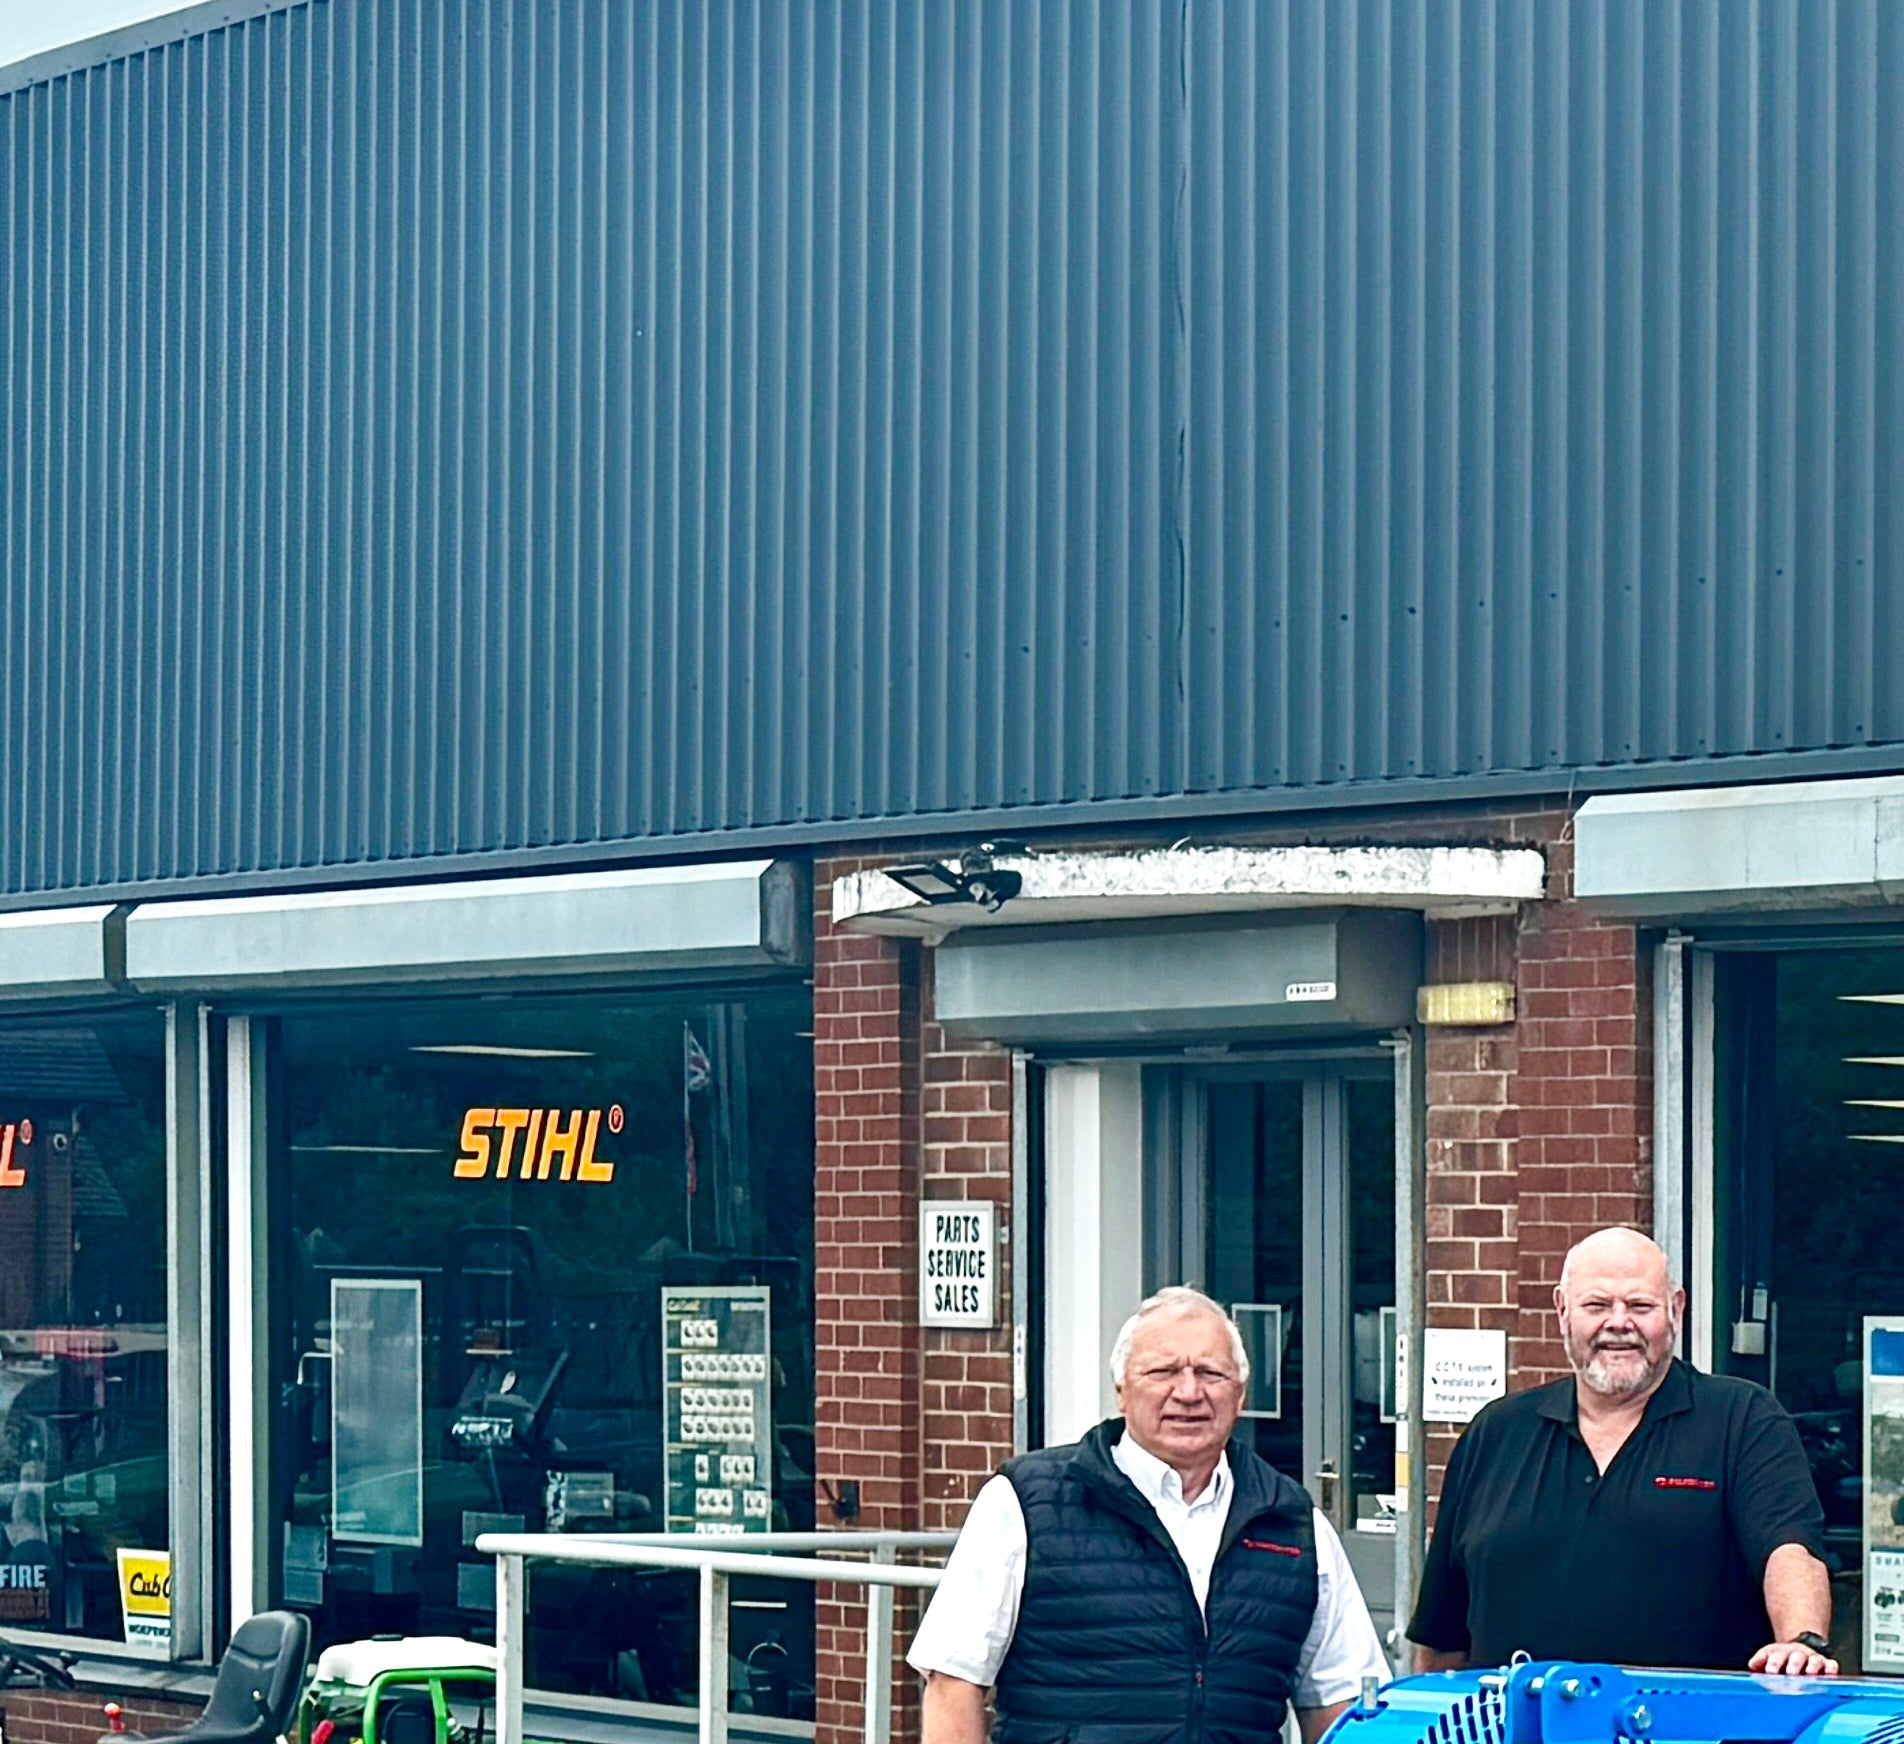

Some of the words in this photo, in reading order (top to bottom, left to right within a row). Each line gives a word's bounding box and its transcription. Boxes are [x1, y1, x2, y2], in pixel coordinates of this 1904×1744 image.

[937, 1215, 980, 1243] PARTS
[928, 1249, 985, 1278] SERVICE
[935, 1283, 979, 1313] SALES
[129, 1571, 161, 1597] Cub
